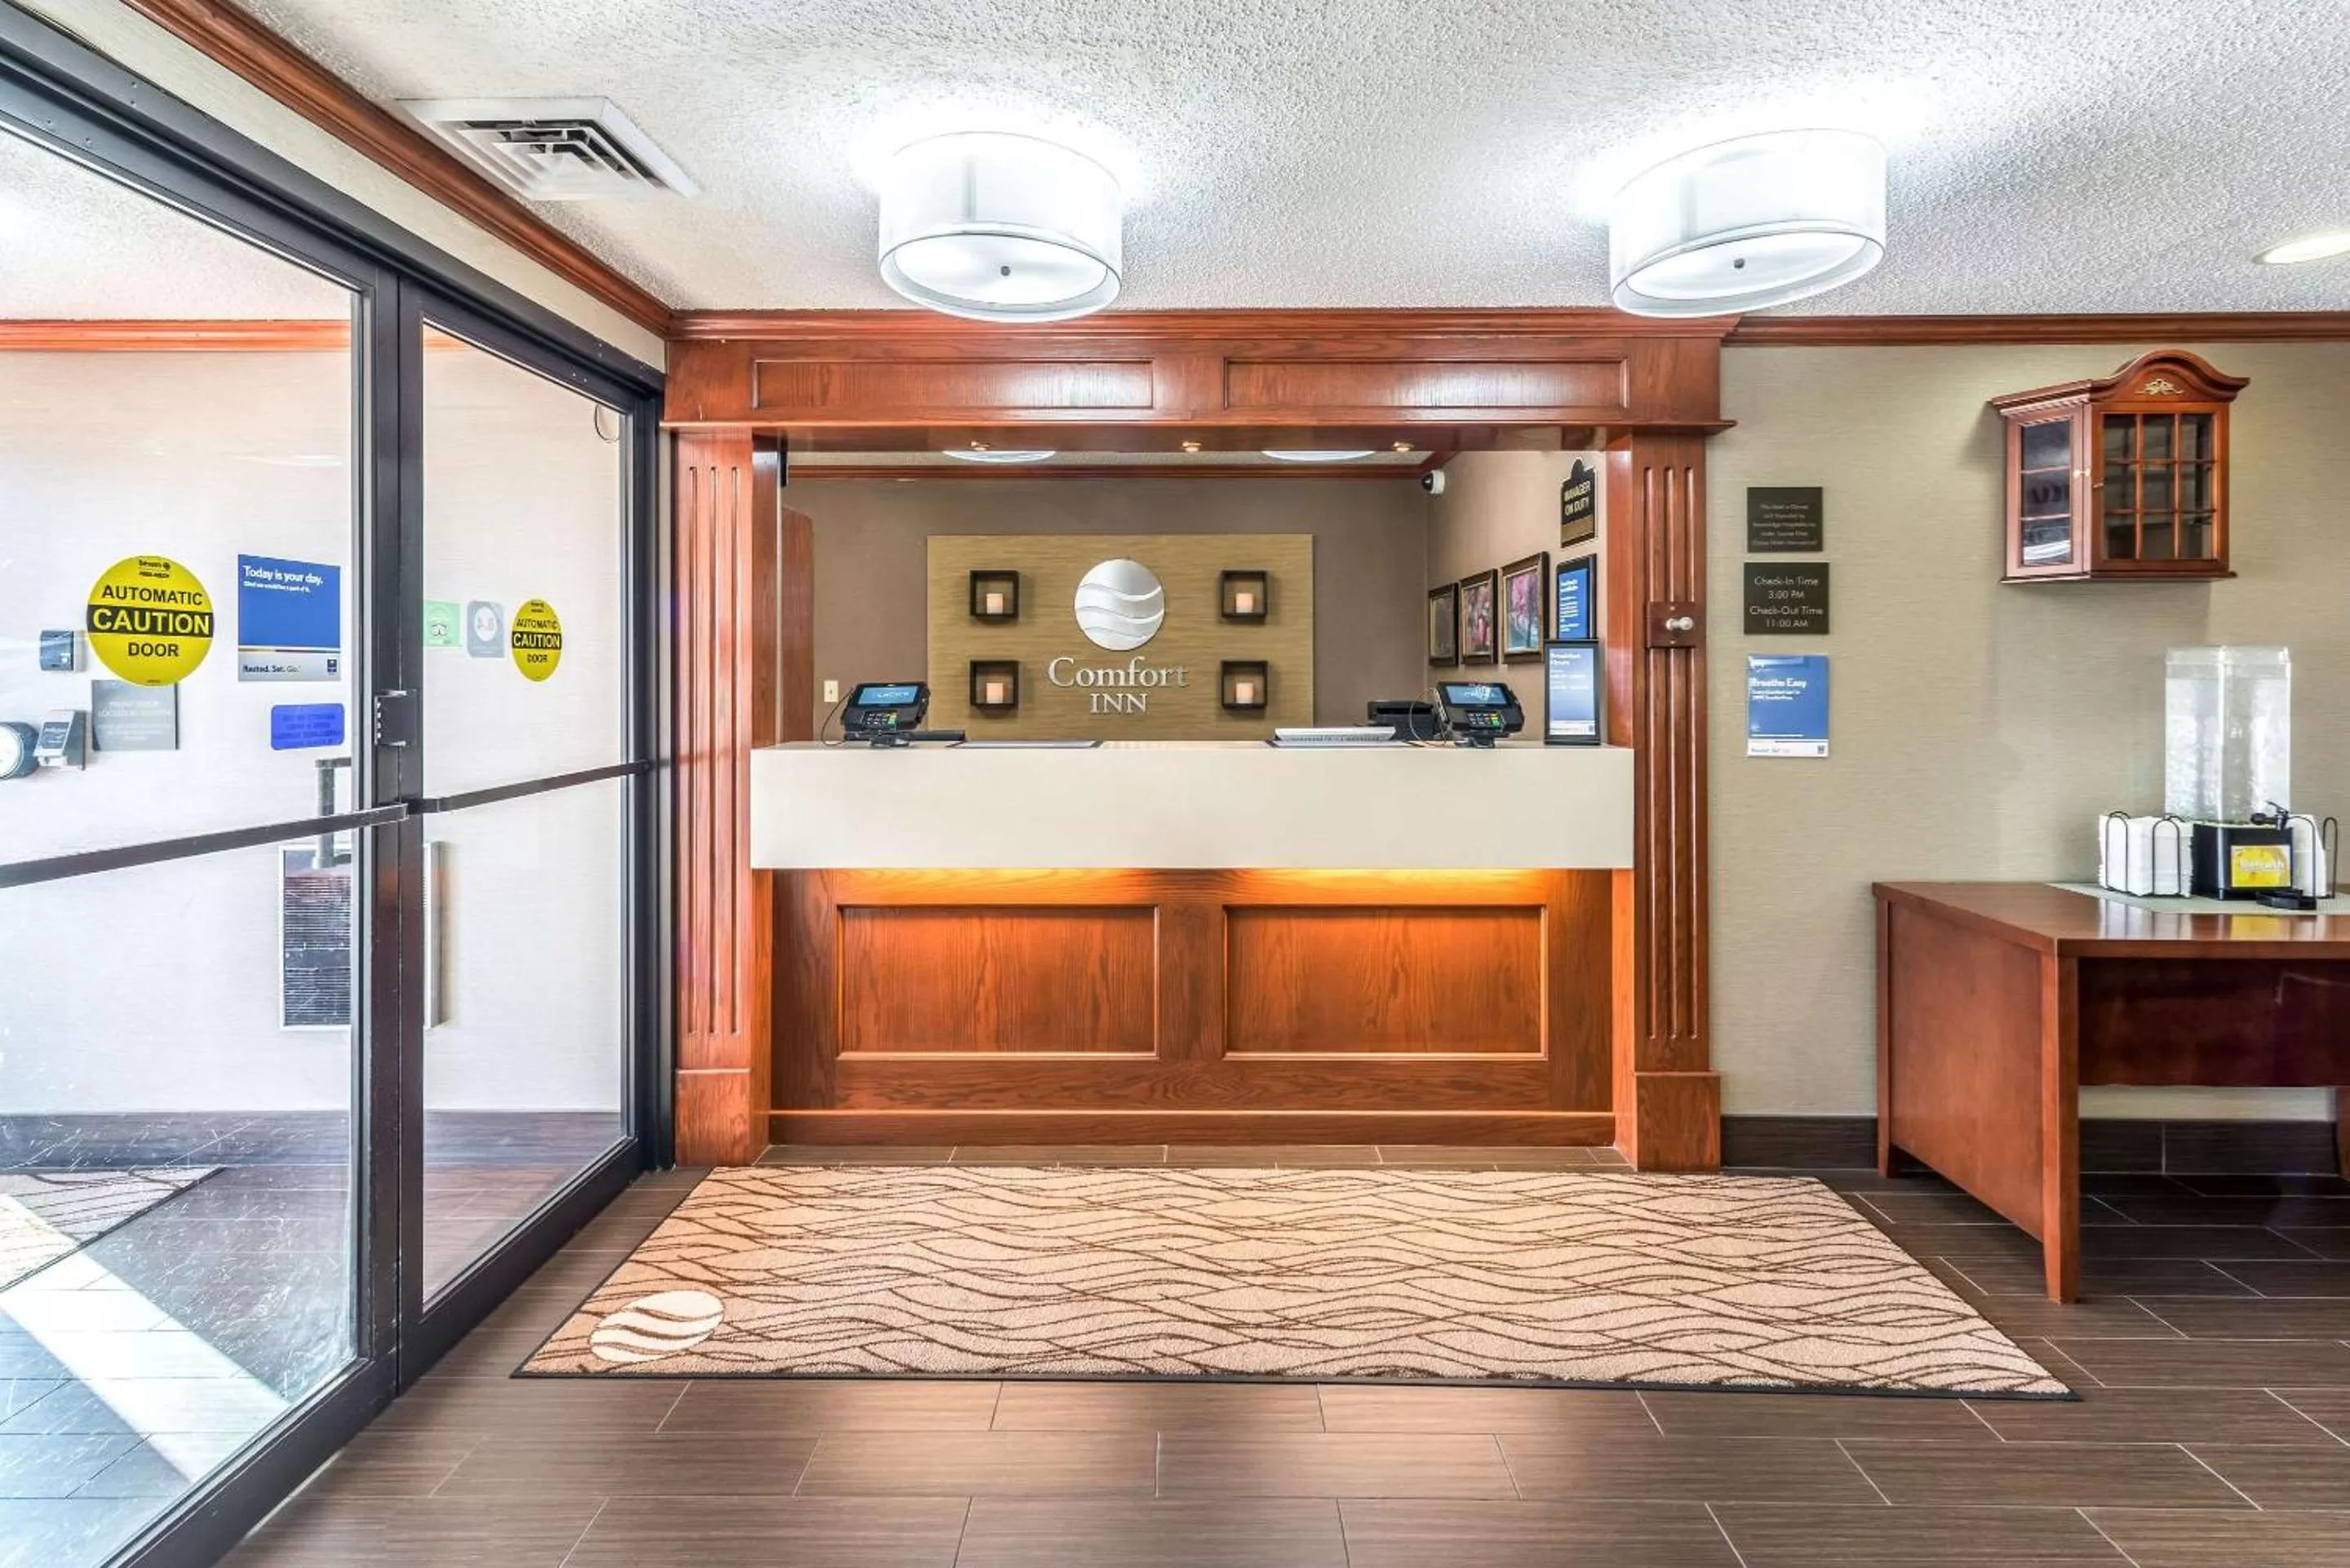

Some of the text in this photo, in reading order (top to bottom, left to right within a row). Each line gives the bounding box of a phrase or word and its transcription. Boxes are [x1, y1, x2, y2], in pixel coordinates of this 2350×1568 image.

[242, 565, 324, 586] Today is your day.
[1754, 576, 1819, 586] Check-In Time
[102, 584, 202, 605] AUTOMATIC
[1768, 590, 1805, 600] 3:00 PM
[1749, 605, 1824, 615] Check-Out Time
[93, 608, 210, 635] CAUTION
[517, 618, 558, 630] AUTOMATIC
[1767, 619, 1809, 627] 11:00 AM
[513, 633, 560, 648] CAUTION
[128, 642, 180, 657] DOOR
[527, 653, 548, 663] DOOR
[1048, 656, 1189, 687] Comfort
[1089, 693, 1148, 713] INN
